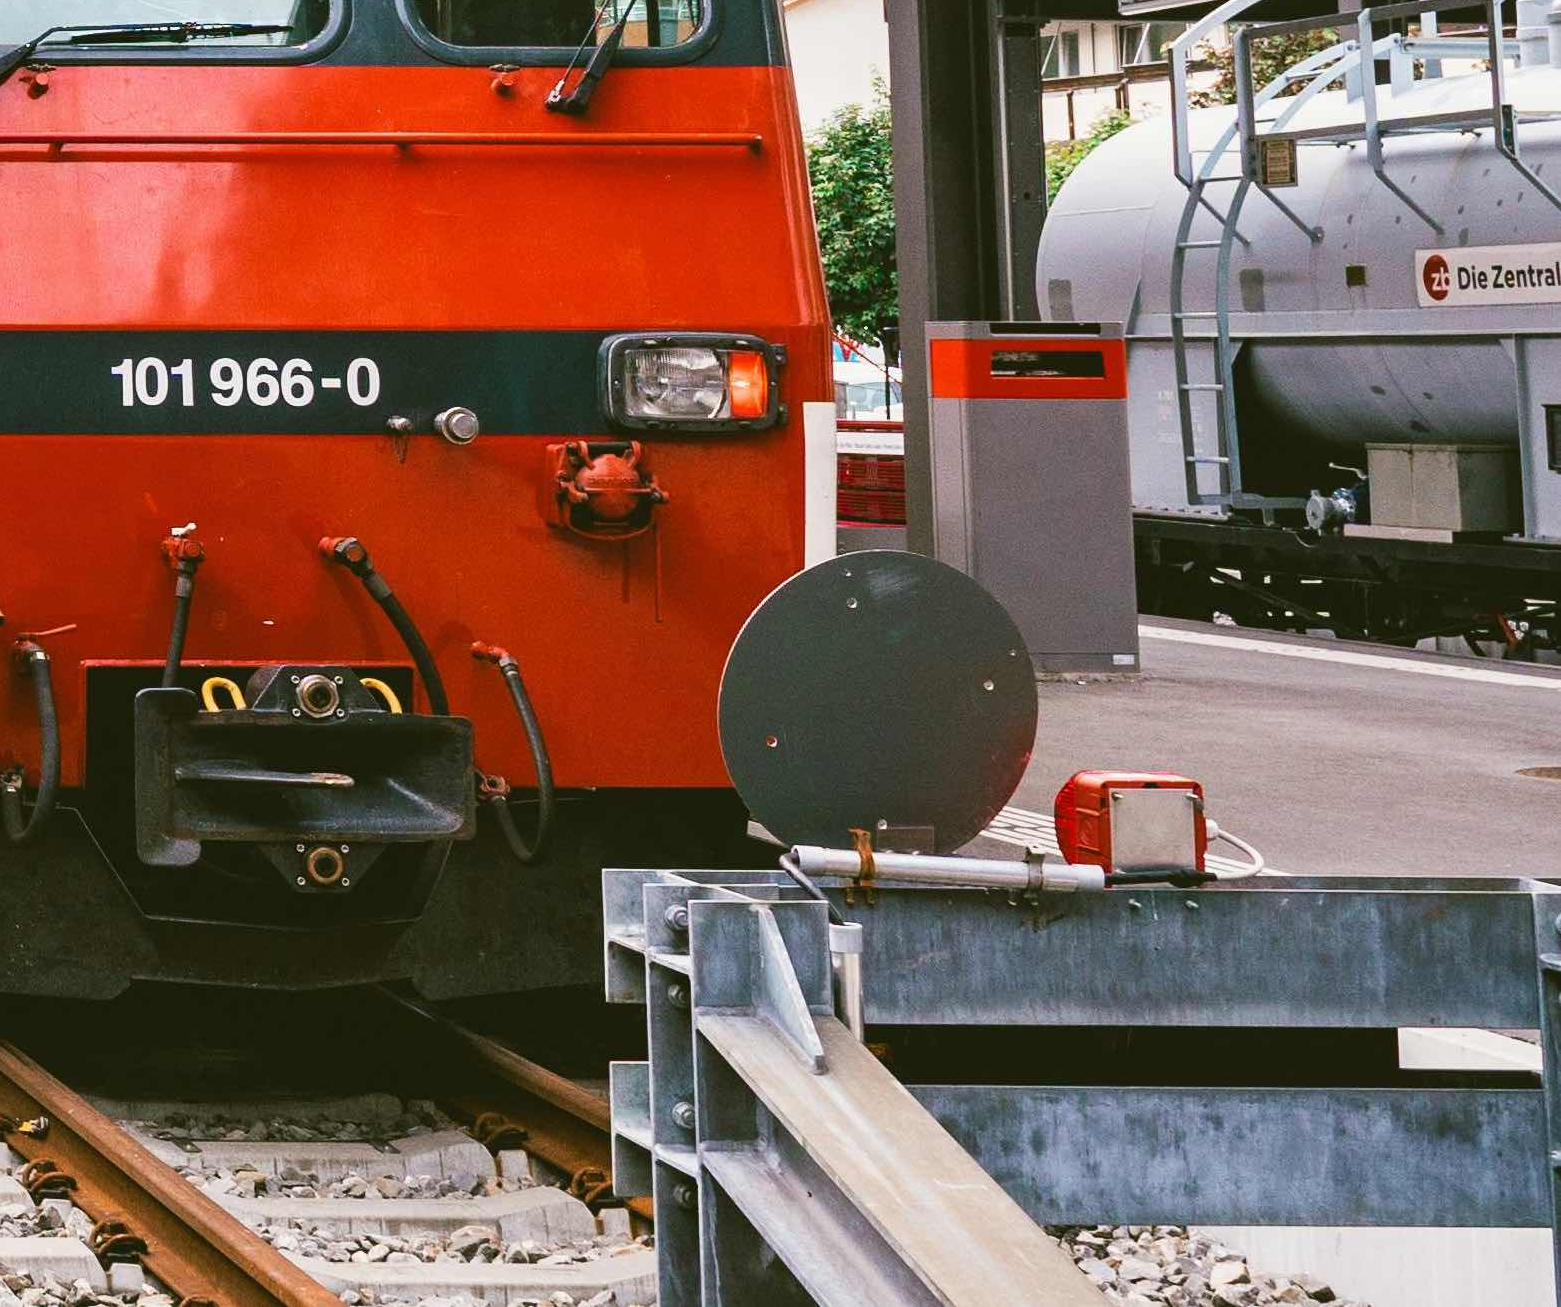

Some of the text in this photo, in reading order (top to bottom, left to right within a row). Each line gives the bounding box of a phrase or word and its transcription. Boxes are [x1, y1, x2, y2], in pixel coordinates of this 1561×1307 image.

[1431, 261, 1561, 292] zb Die Zentral
[110, 357, 381, 407] 101 966-0
